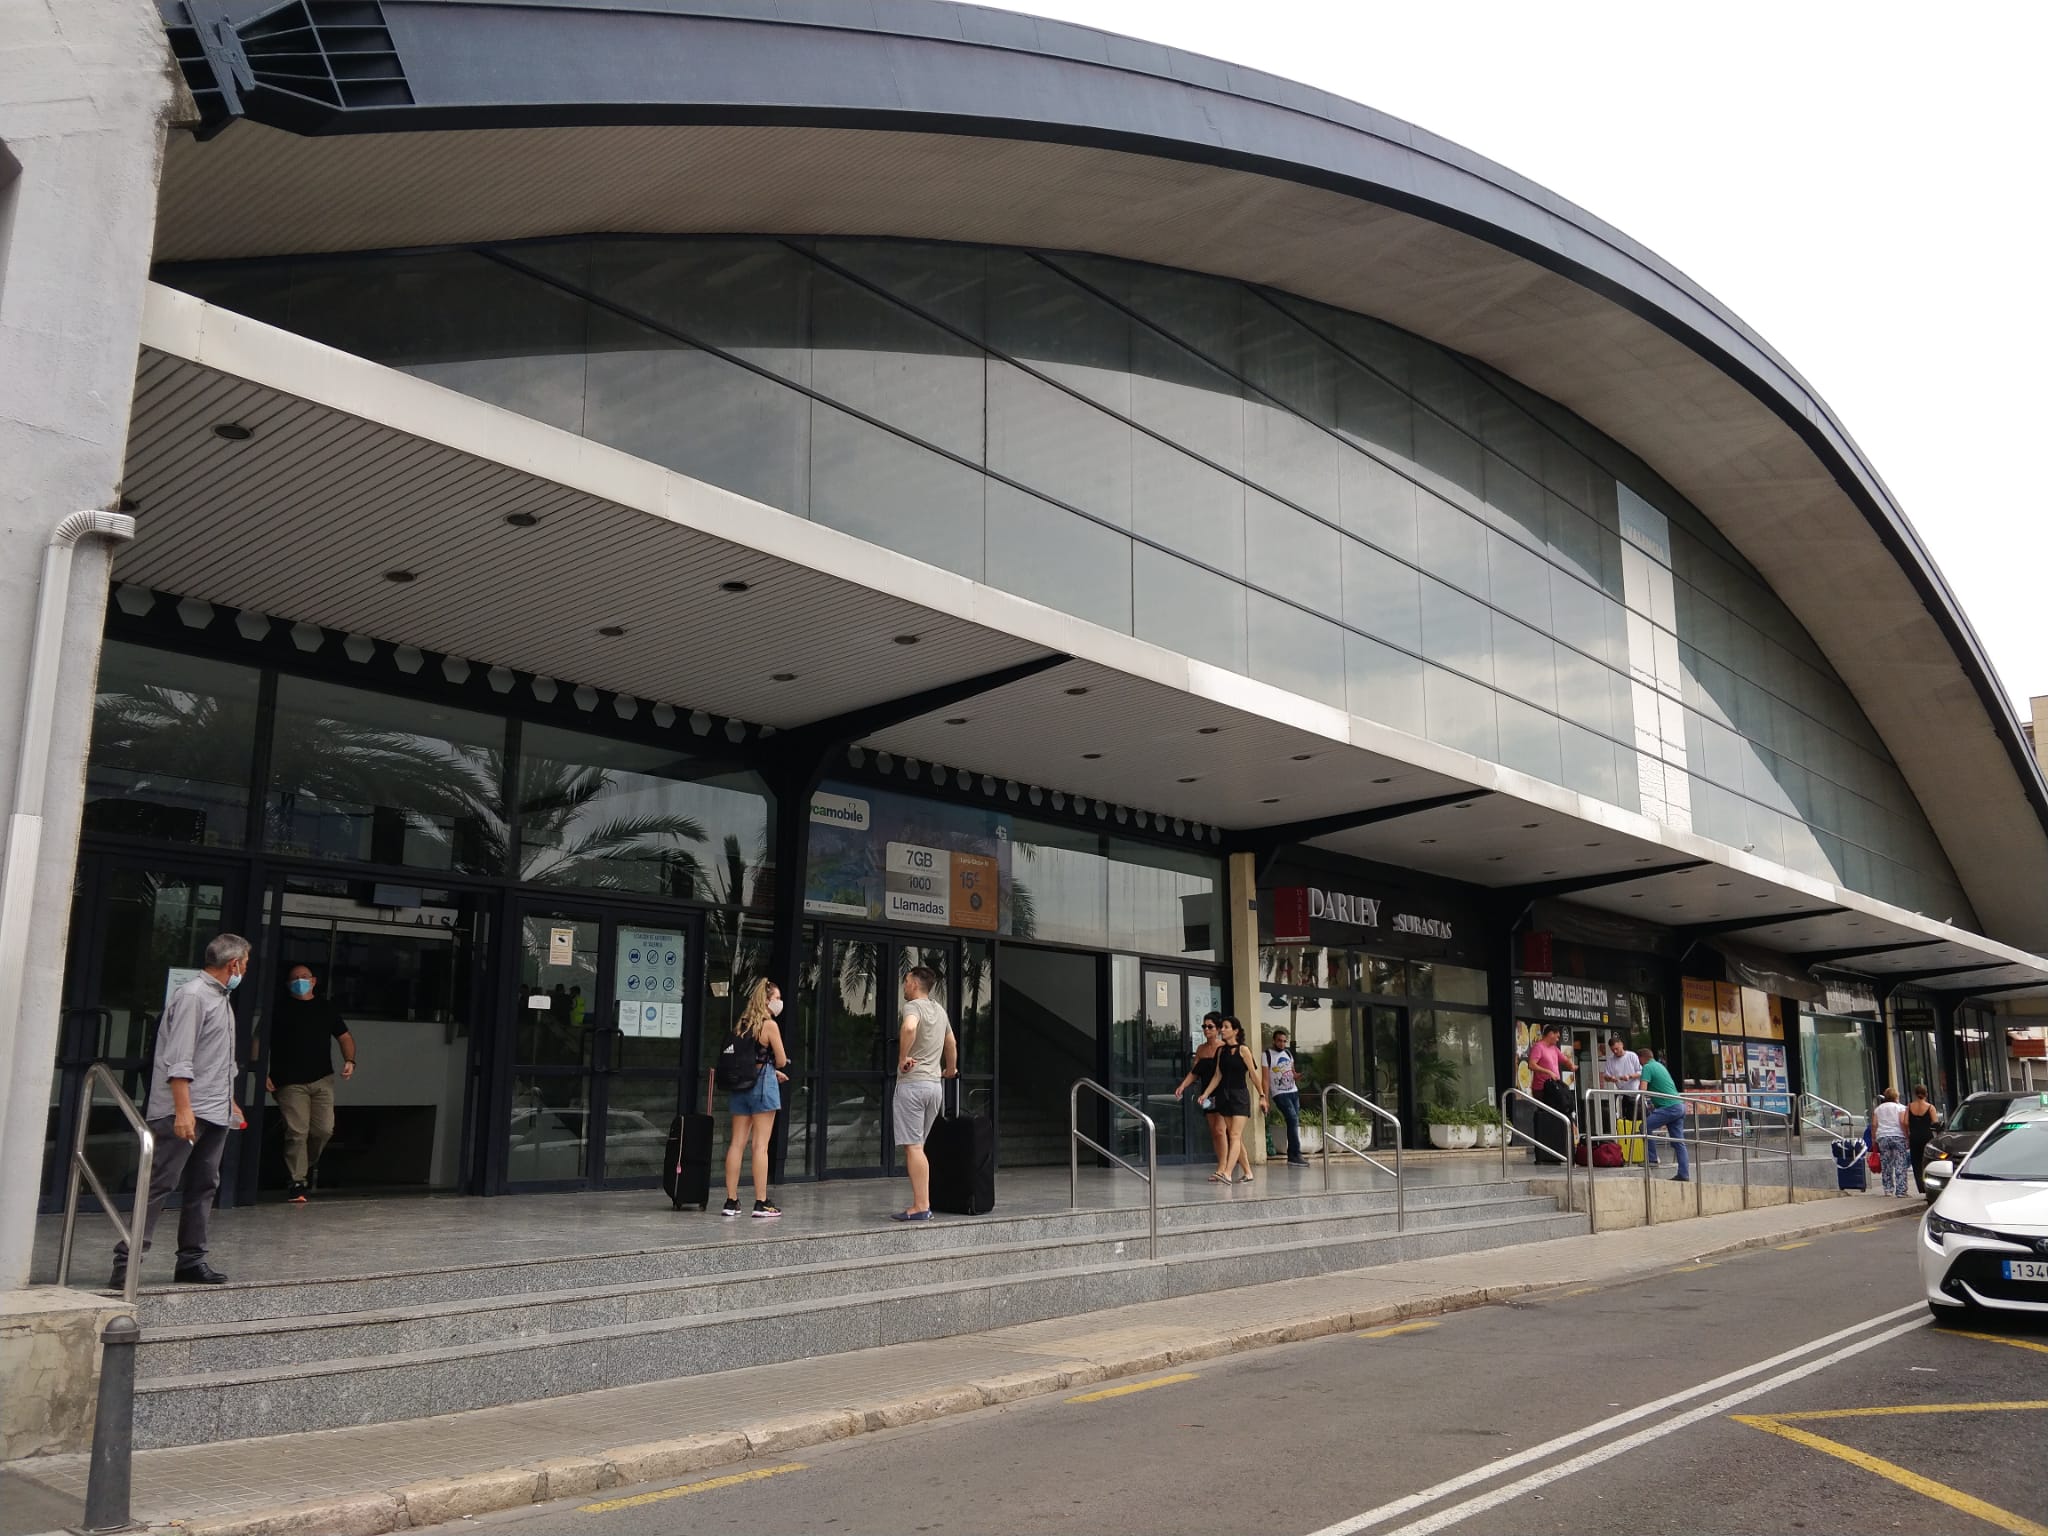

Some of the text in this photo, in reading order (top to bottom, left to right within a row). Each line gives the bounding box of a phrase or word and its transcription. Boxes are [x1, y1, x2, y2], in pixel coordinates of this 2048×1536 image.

[907, 850, 933, 868] 7GB
[909, 876, 931, 890] 1000
[893, 895, 944, 914] Llamadas
[1308, 887, 1381, 927] DARLEY
[1395, 913, 1452, 939] SUBASTAS
[1533, 979, 1544, 1000] BAR
[1565, 984, 1583, 1005] KEBAB
[1543, 1006, 1601, 1022] COMIDAS PARA LLEVAR
